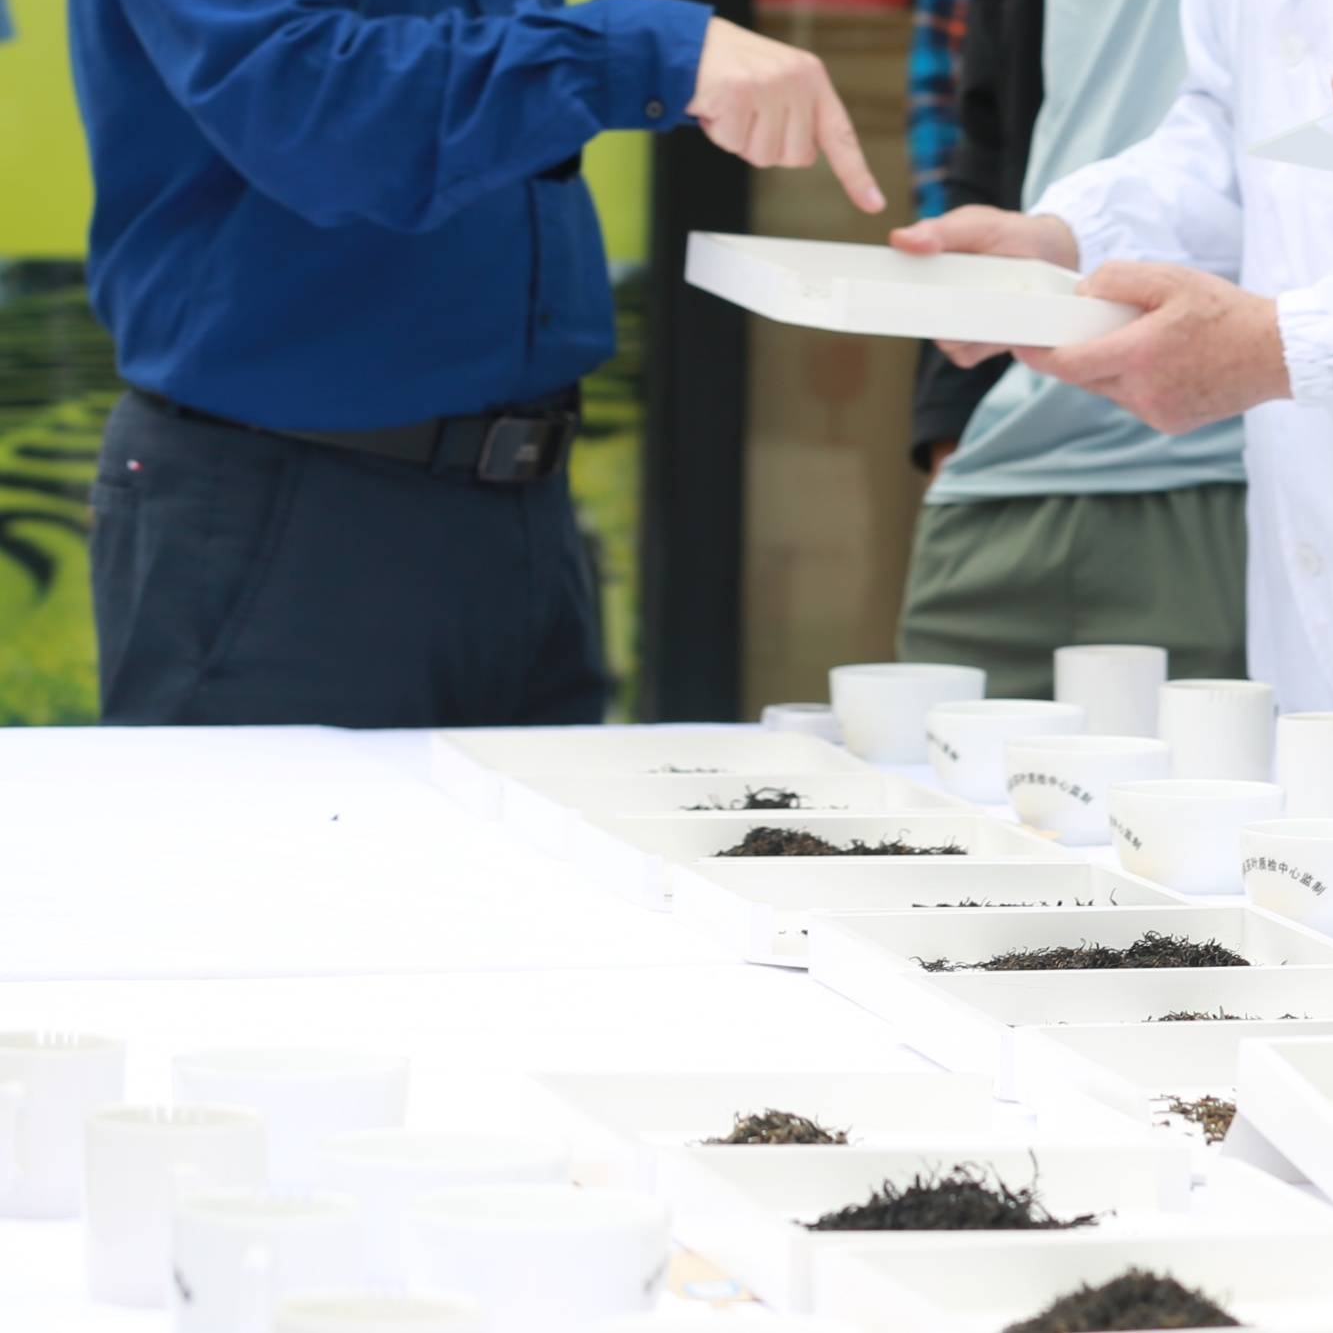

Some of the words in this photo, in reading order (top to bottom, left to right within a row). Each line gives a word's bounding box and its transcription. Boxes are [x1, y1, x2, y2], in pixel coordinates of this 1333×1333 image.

[1242, 857, 1328, 896] 茶叶质检中心监制
